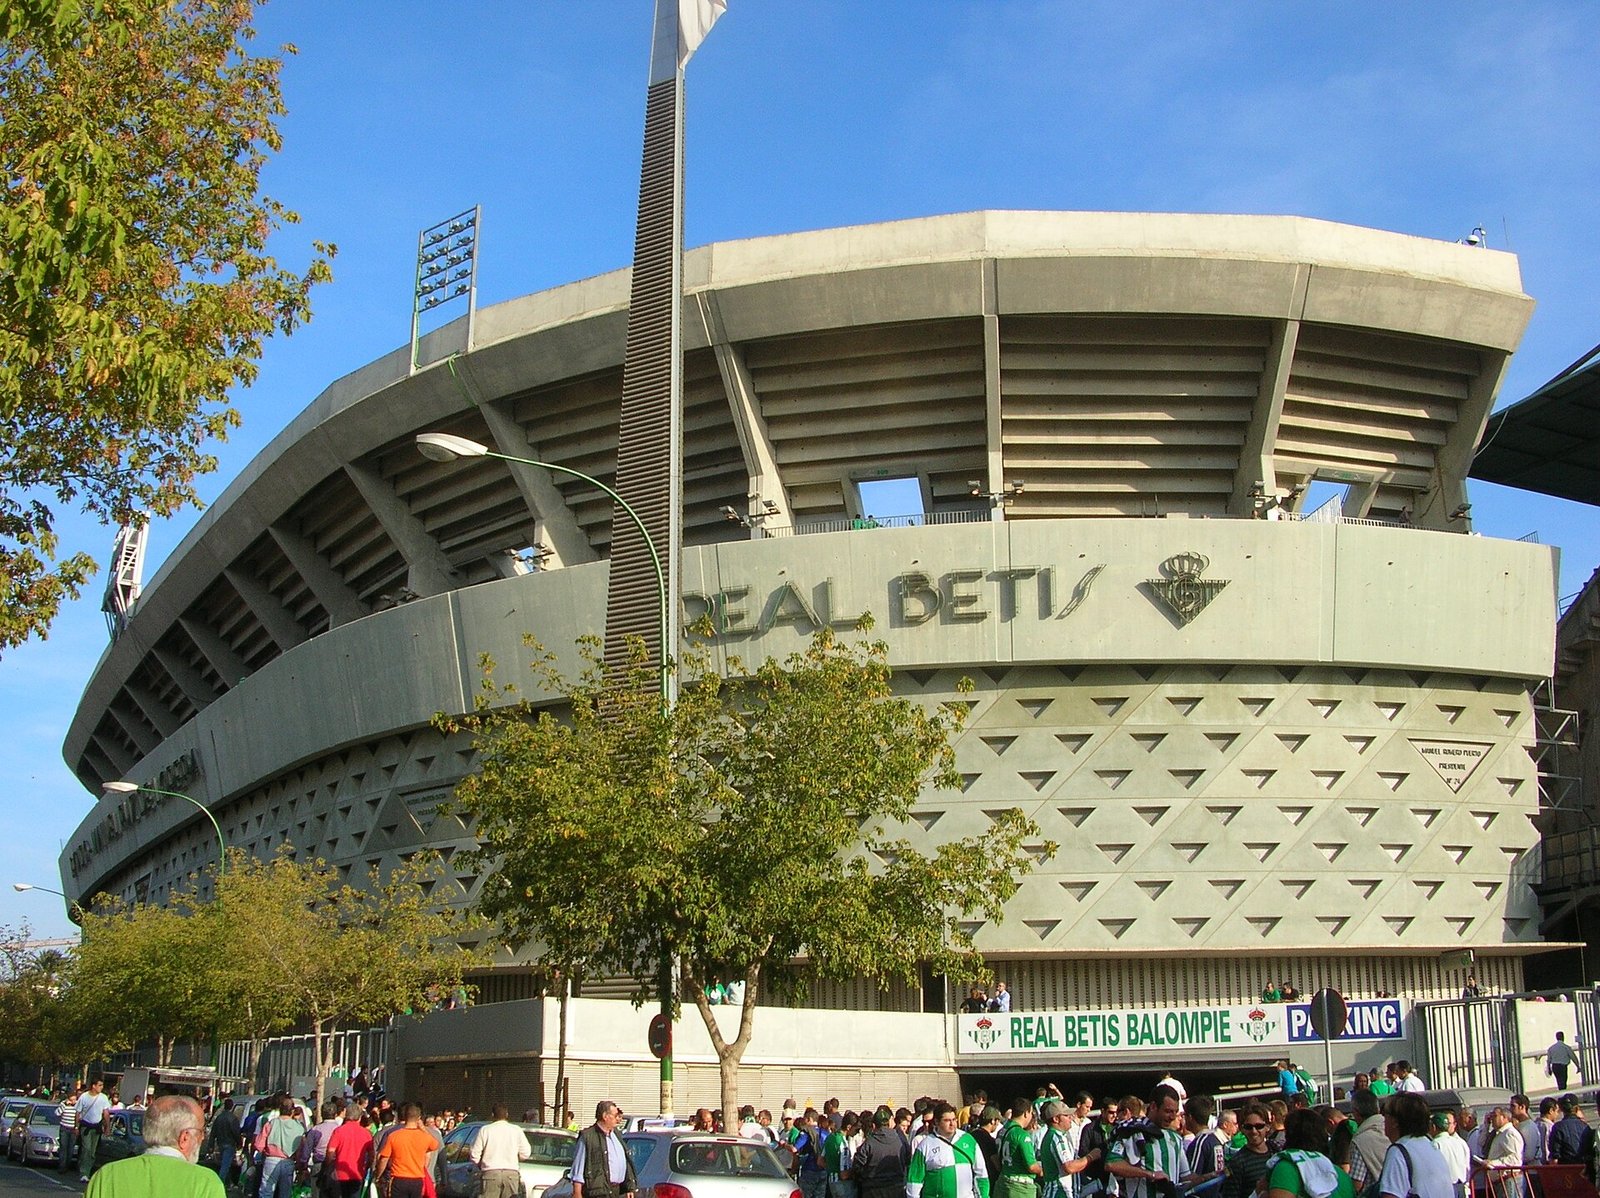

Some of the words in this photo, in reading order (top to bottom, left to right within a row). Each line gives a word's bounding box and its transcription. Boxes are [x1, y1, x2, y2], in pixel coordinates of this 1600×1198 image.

[681, 576, 864, 643] REAL
[889, 564, 1107, 629] BETIS
[1010, 1016, 1058, 1048] REAL
[1065, 1014, 1120, 1046] BETIS
[1127, 1010, 1231, 1045] BALOMPIE
[1291, 1005, 1397, 1038] PKING
